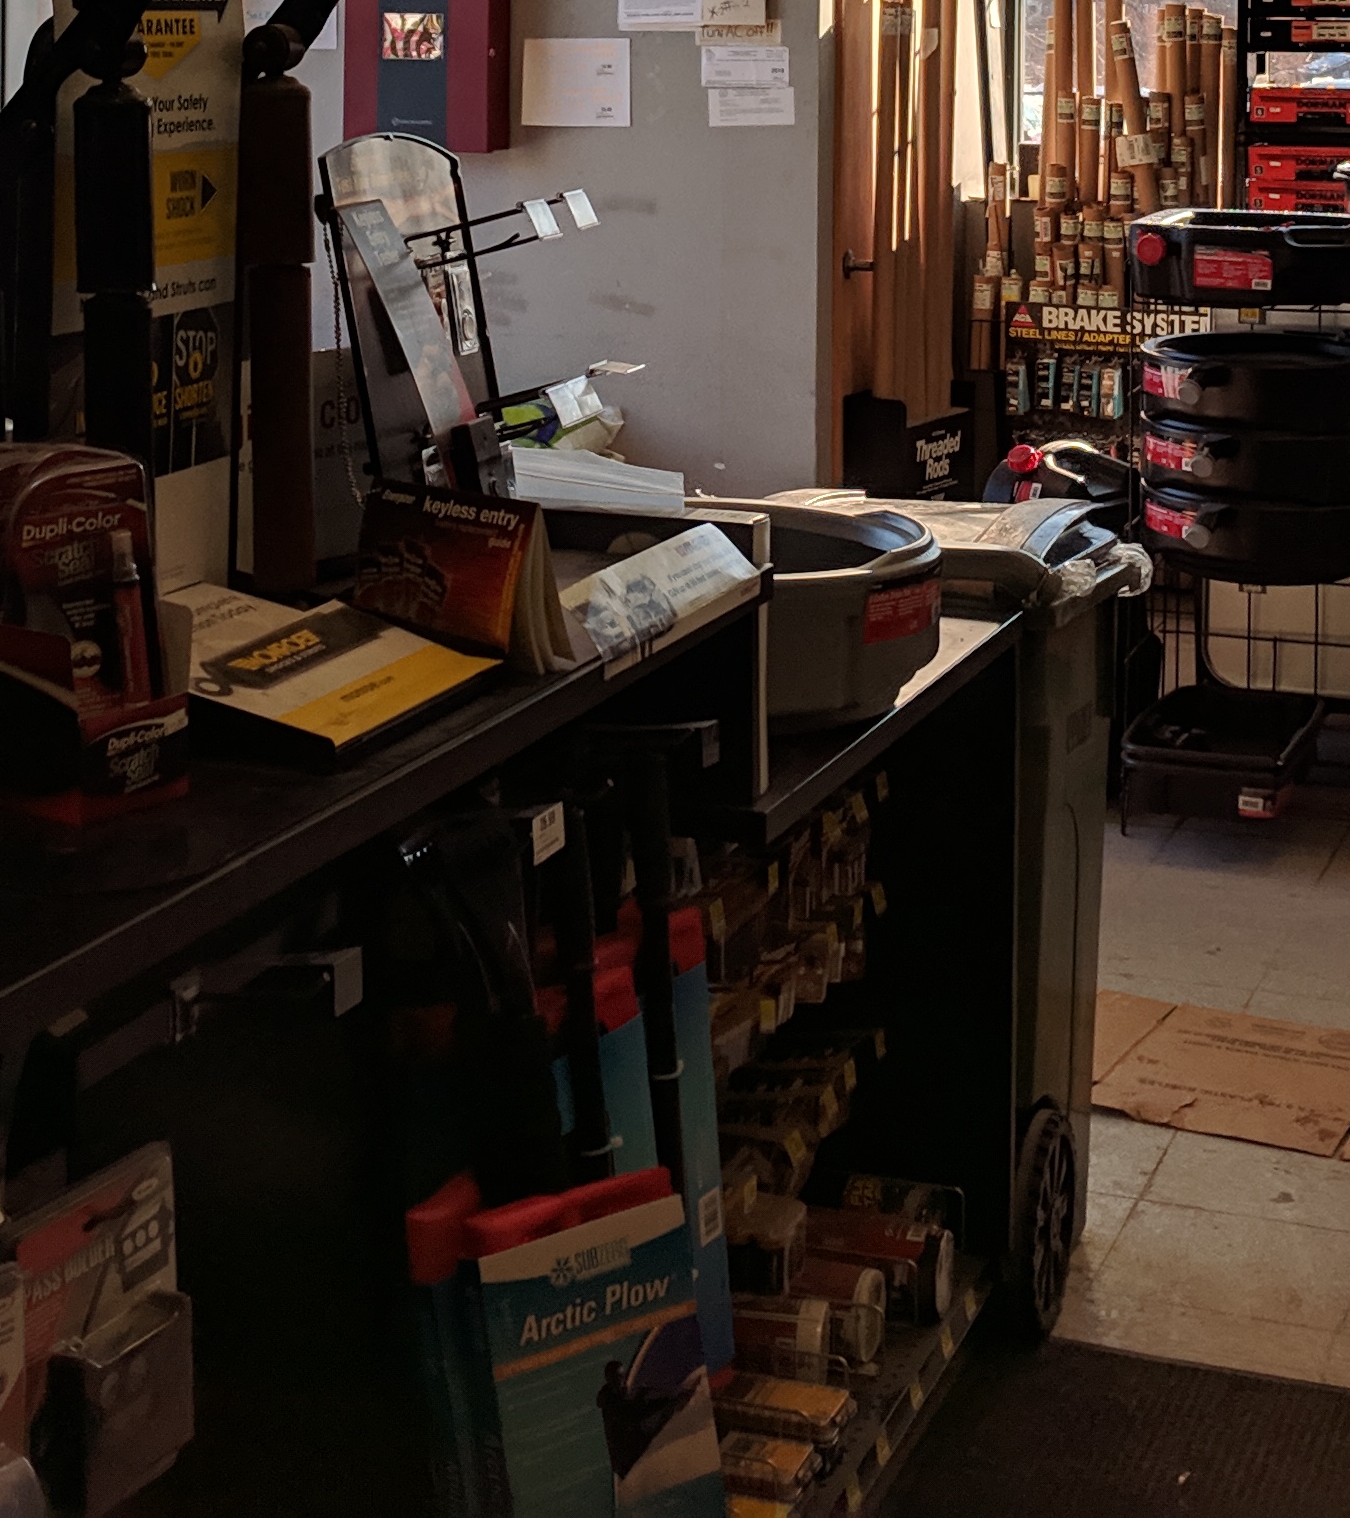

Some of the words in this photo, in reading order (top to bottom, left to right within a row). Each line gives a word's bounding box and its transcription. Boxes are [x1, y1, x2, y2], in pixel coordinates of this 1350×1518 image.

[137, 18, 195, 35] ARANTEE
[153, 96, 175, 113] Your
[177, 93, 209, 113] Safety
[157, 117, 216, 138] Experience.
[1042, 305, 1121, 333] BRAKE
[1008, 326, 1042, 340] STEEL
[1044, 329, 1075, 341] LINES
[175, 328, 218, 367] STOP
[915, 430, 962, 463] Threaded
[924, 457, 950, 482] Rods
[422, 494, 478, 520] keyless
[479, 507, 520, 532] entry
[519, 1297, 597, 1347] Arctic
[604, 1275, 670, 1316] Plow
